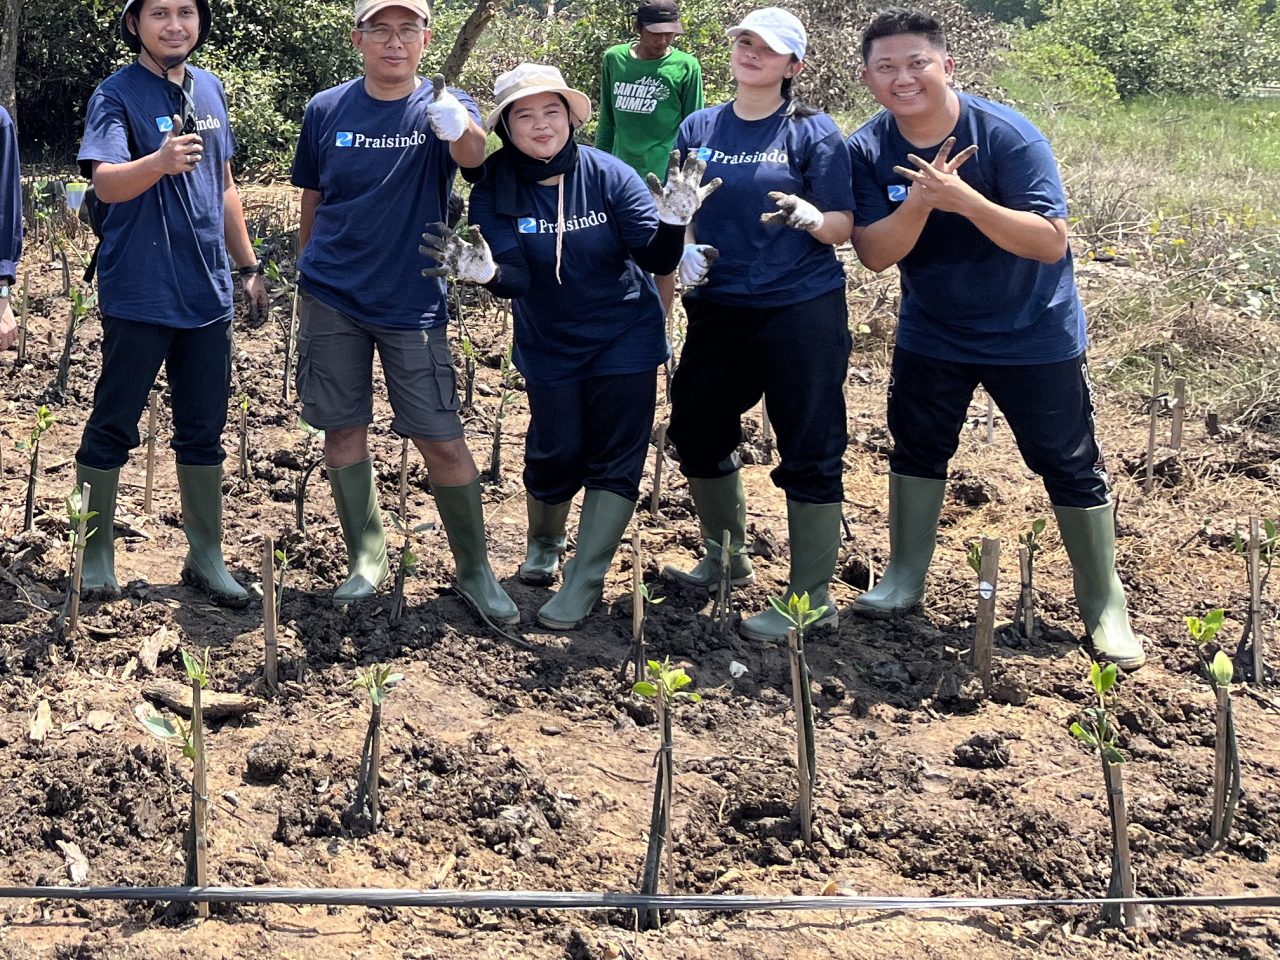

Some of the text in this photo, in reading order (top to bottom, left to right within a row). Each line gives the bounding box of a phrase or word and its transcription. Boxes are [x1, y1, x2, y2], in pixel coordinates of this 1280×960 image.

[635, 76, 662, 87] Aksi
[354, 130, 426, 148] Praisindo
[711, 148, 789, 165] Praisindo
